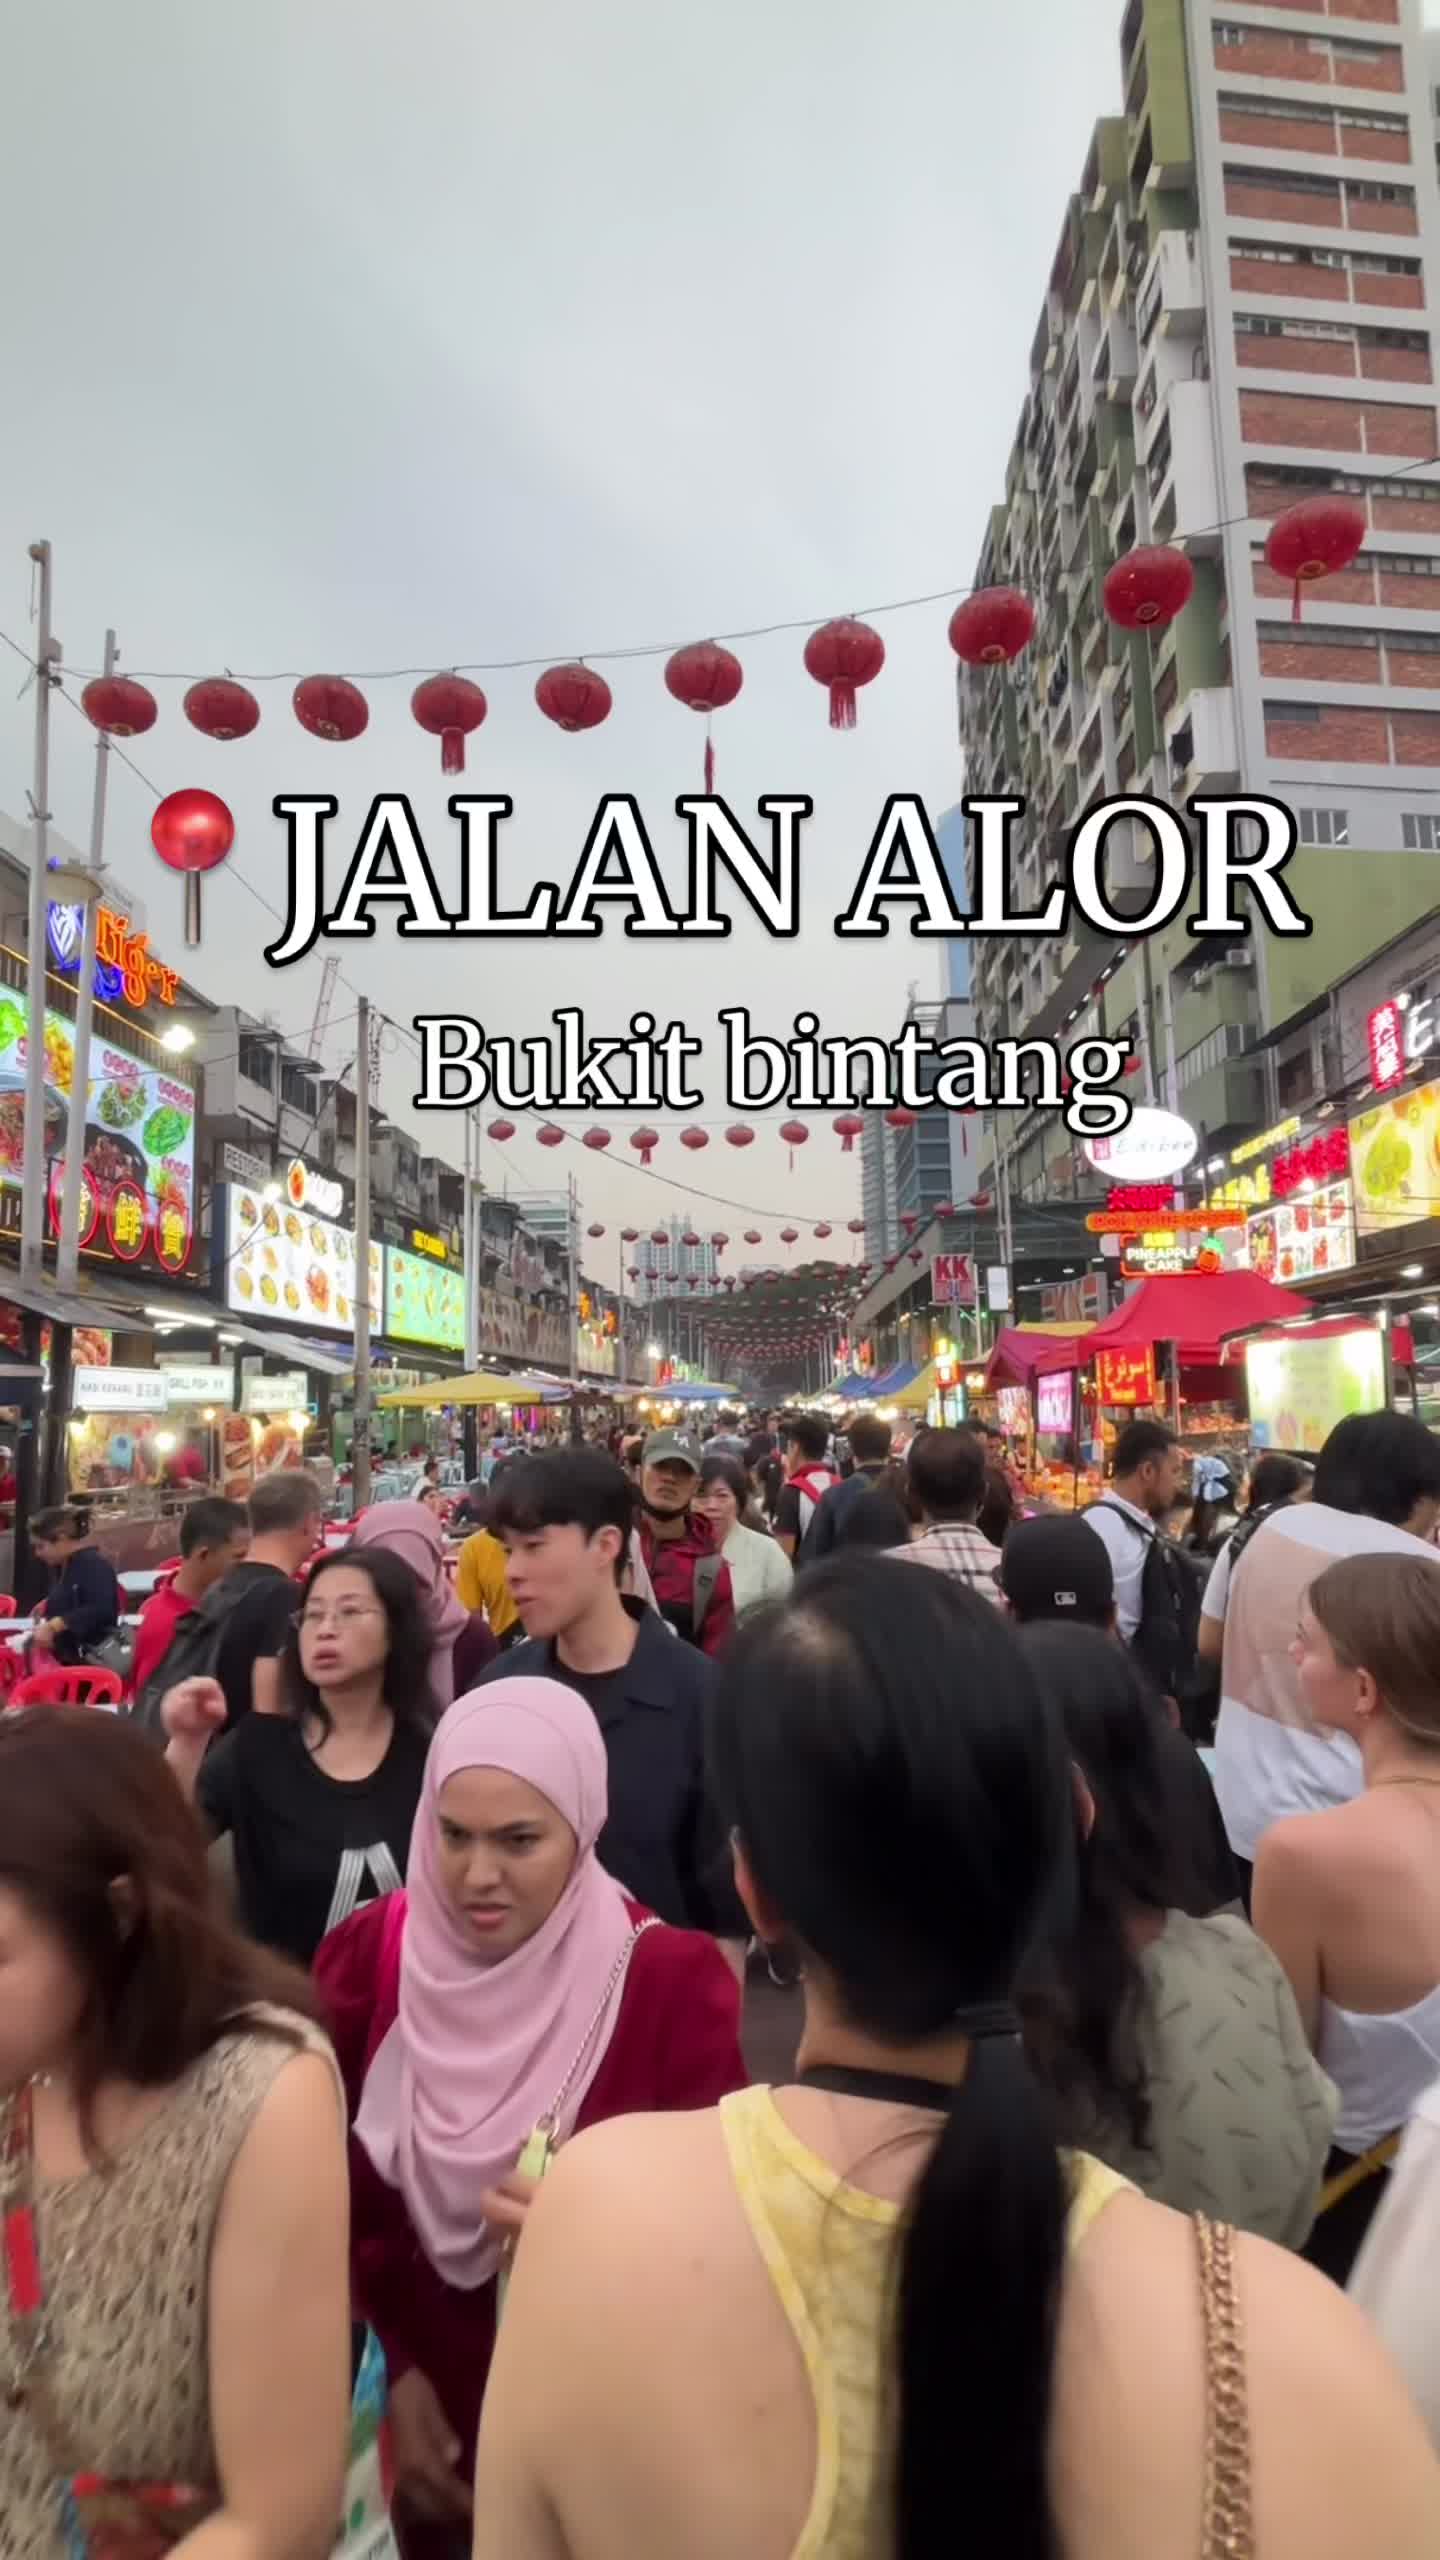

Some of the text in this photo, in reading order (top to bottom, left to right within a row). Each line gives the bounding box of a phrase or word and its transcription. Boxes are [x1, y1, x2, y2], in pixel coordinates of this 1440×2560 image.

[1126, 1246, 1200, 1261] PINEAPPLE
[935, 1254, 969, 1281] KK
[1143, 1258, 1184, 1273] CAKE
